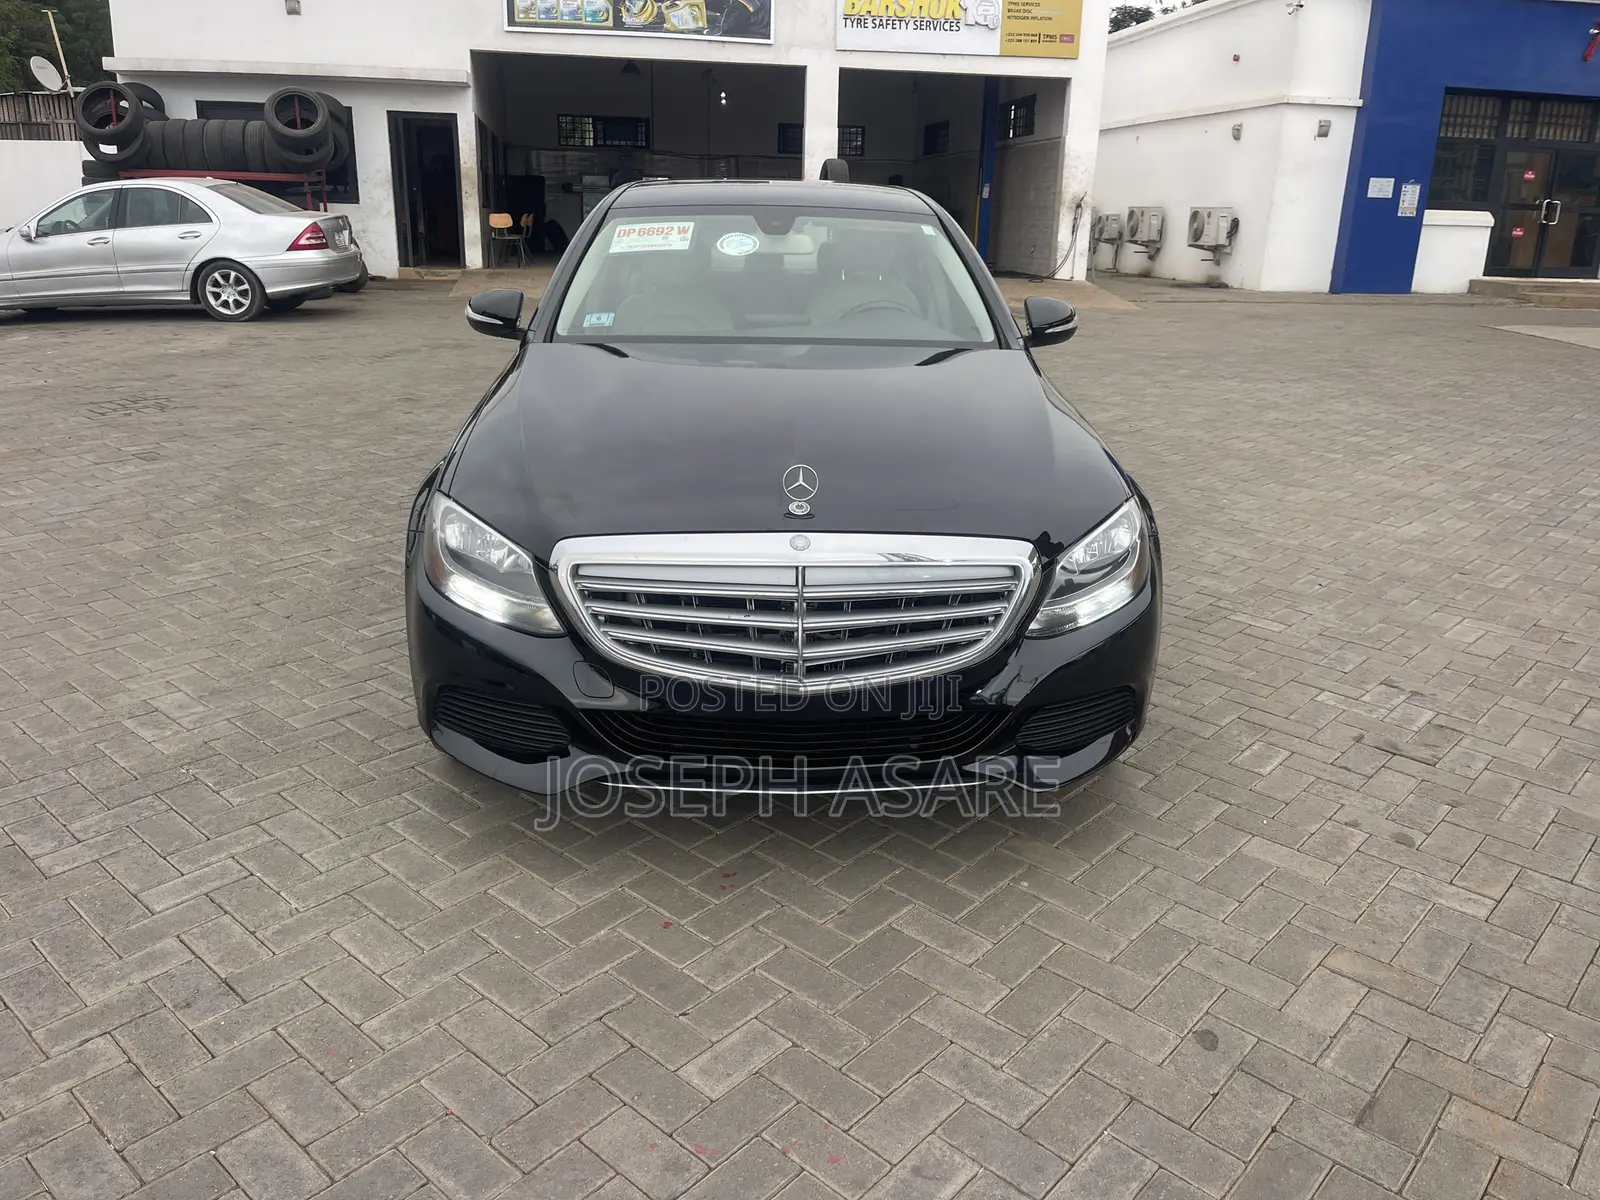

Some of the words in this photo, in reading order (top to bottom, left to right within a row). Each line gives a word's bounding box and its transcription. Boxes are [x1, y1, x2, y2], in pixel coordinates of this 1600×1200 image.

[843, 17, 869, 29] TYRE
[871, 18, 911, 30] SAFETY
[913, 19, 961, 32] SERVICES
[616, 229, 636, 238] DP
[637, 226, 674, 237] 6692
[677, 225, 690, 235] W
